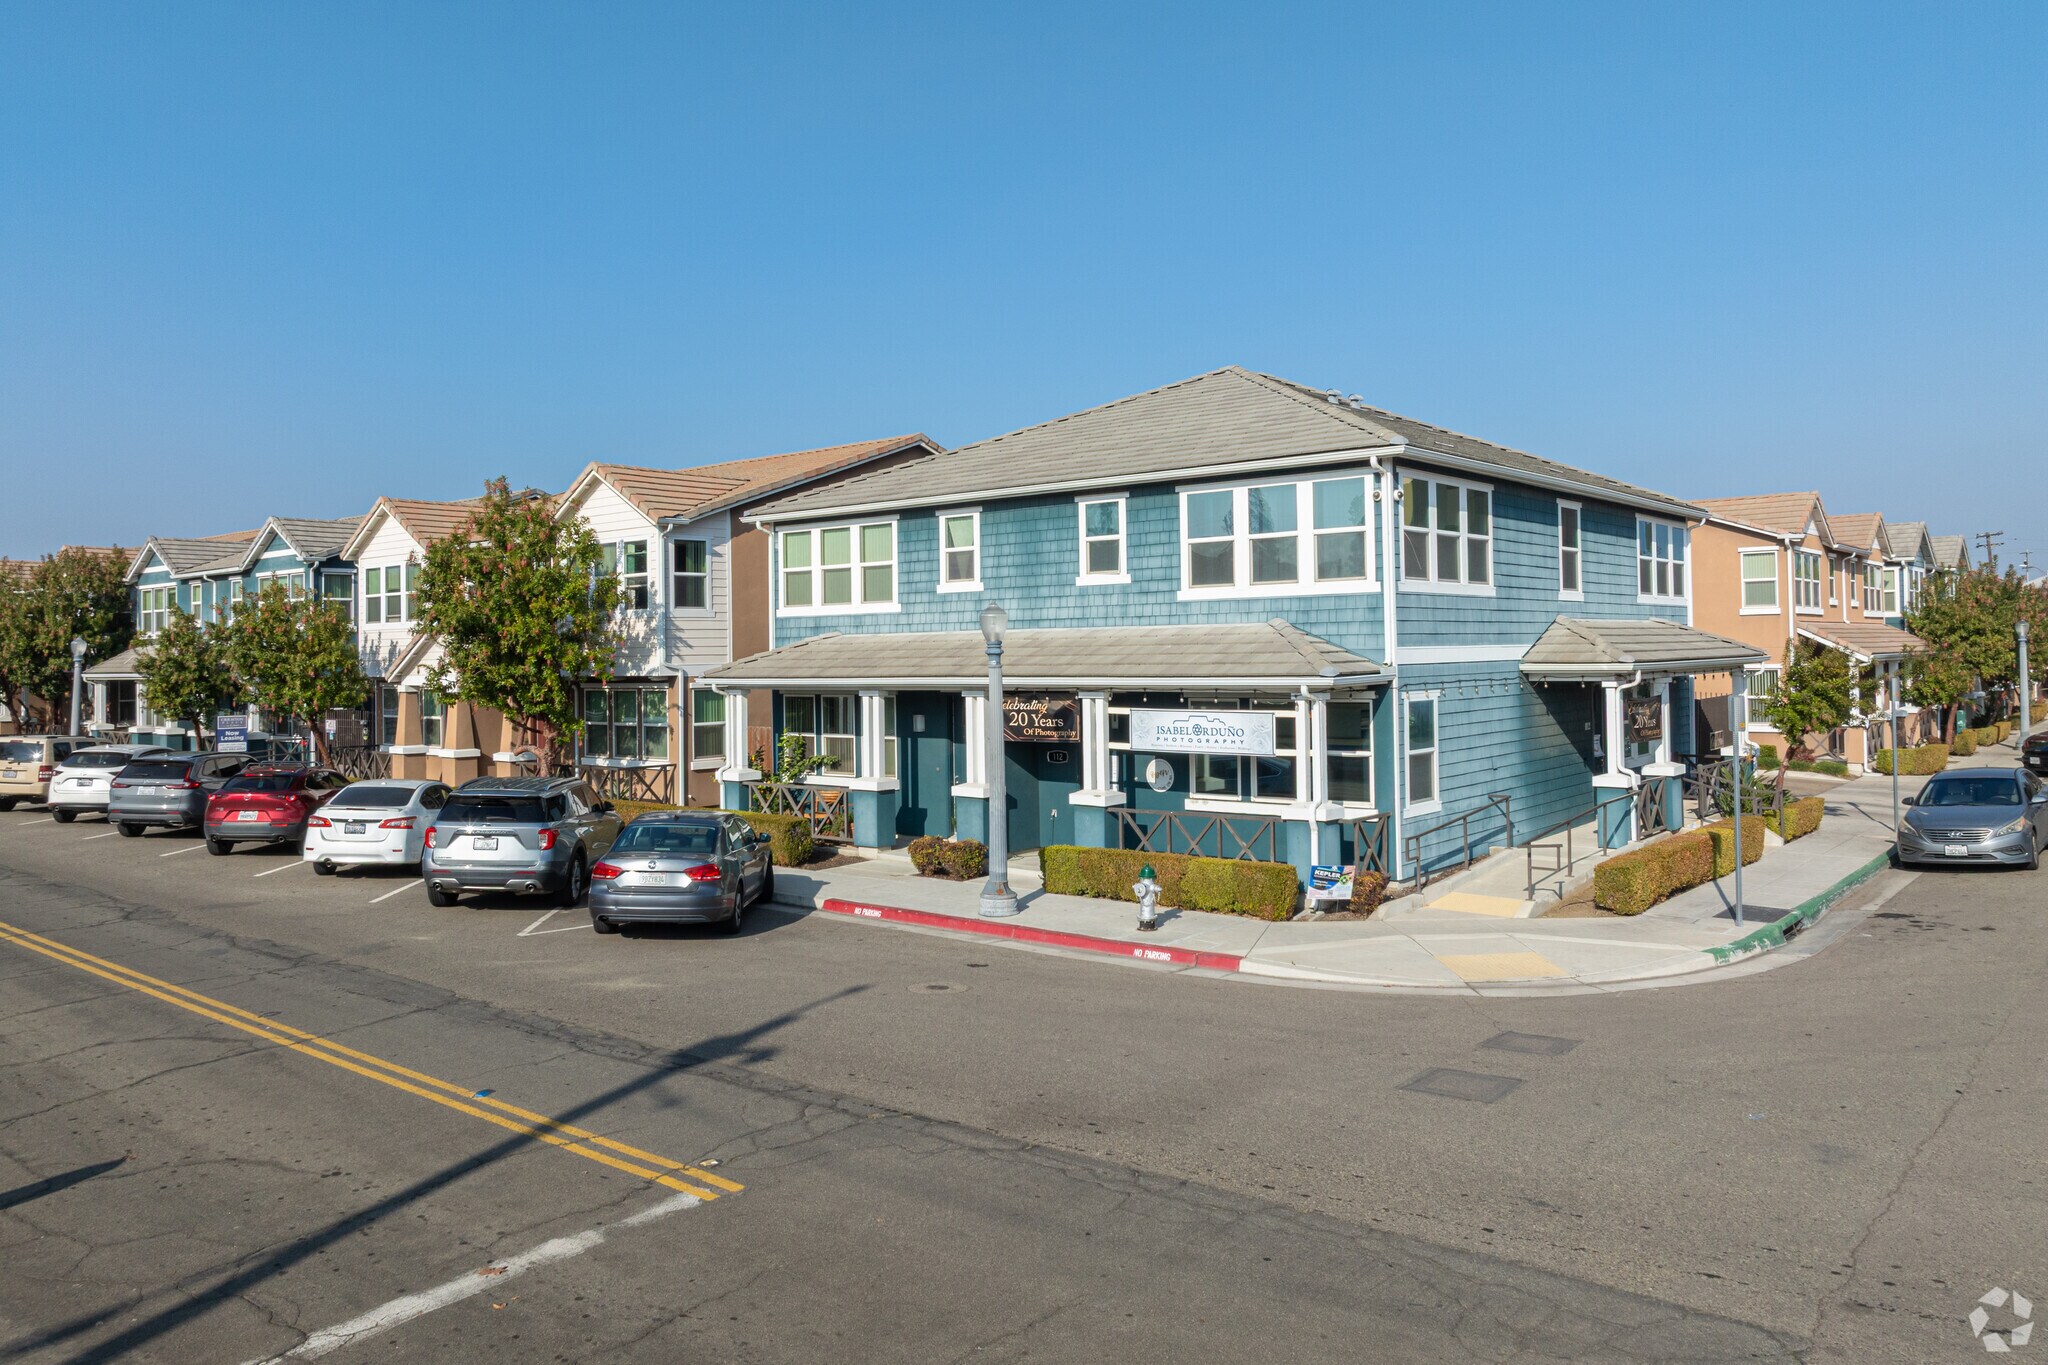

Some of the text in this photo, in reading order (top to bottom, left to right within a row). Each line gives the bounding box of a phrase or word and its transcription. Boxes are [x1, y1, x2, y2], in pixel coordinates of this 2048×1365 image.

[1003, 700, 1047, 714] elebrating
[1009, 712, 1063, 727] 20 Years
[1633, 714, 1643, 728] 20
[1023, 728, 1076, 738] Of Photography
[1156, 726, 1192, 736] ISABEL
[1156, 737, 1245, 745] PHOTOGRAPHY
[1053, 753, 1063, 761] 112
[1314, 869, 1341, 878] KEPLER
[862, 908, 882, 918] PARKING
[1133, 948, 1171, 962] NO PARKING
